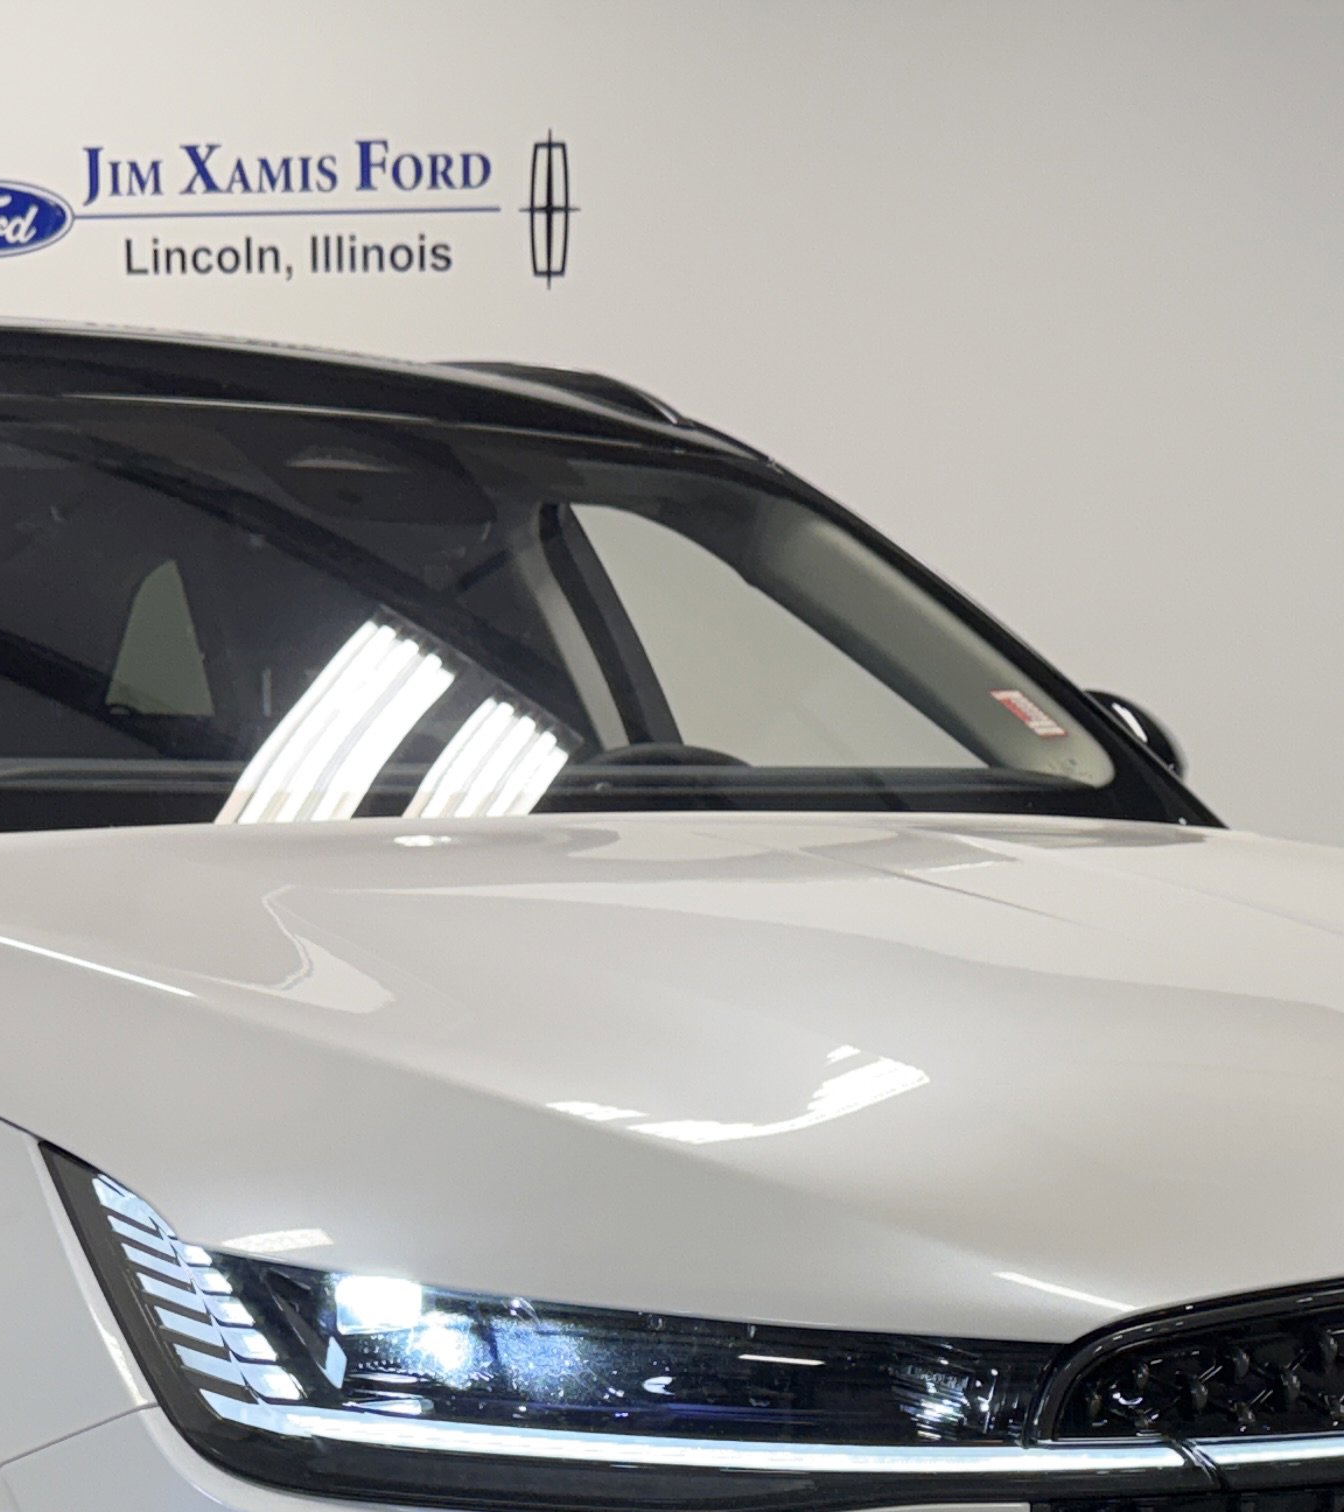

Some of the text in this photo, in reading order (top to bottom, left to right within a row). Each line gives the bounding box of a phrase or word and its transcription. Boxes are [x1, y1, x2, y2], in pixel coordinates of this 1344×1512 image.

[83, 139, 492, 206] JIM XAMIS FORD
[124, 233, 454, 282] Lincoln, Illinois
